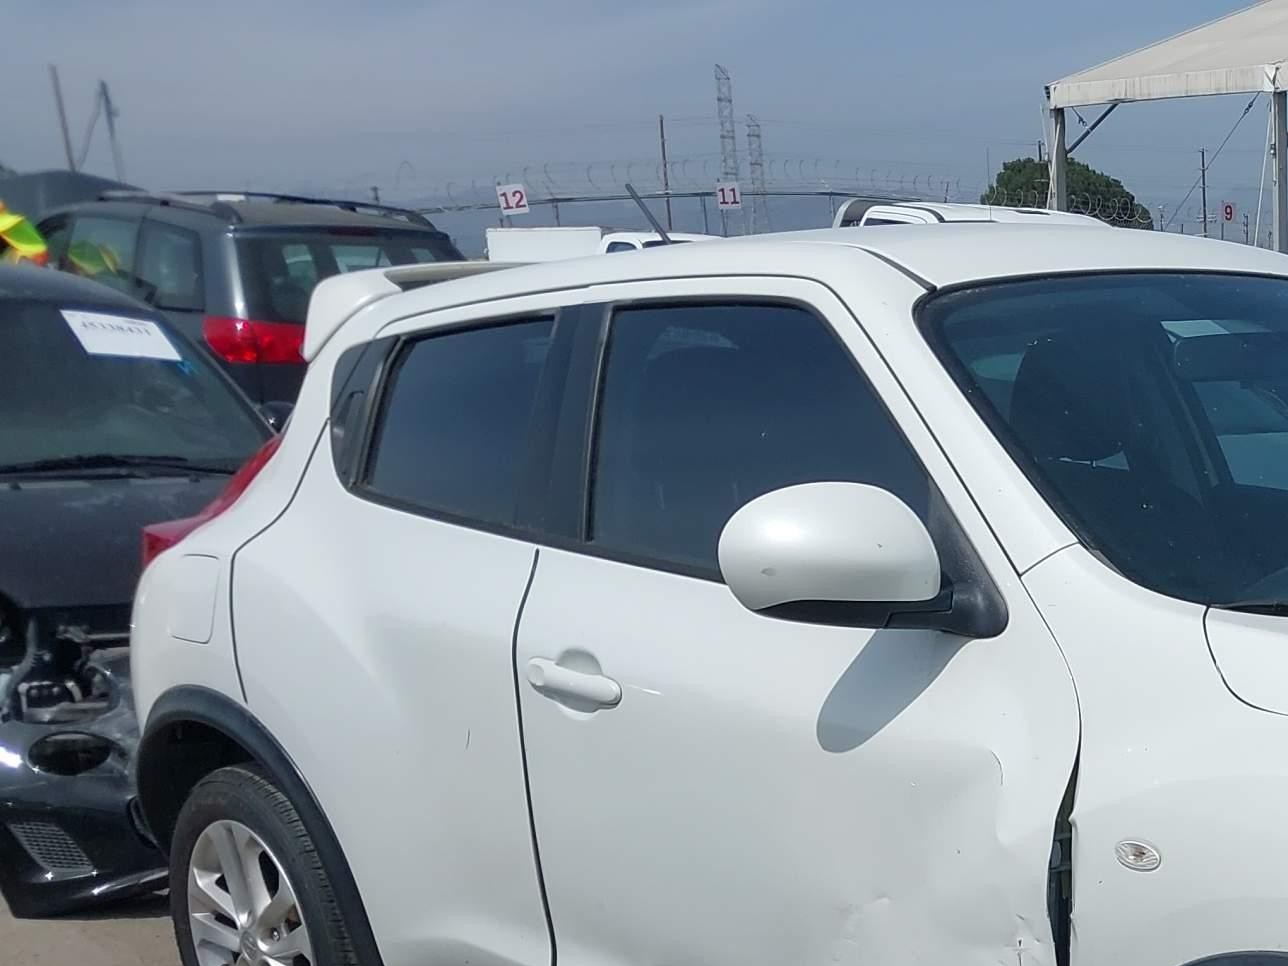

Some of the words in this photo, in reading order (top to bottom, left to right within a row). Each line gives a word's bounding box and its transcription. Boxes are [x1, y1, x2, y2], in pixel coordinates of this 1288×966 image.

[500, 190, 527, 210] 12
[718, 187, 740, 205] 11
[1224, 205, 1233, 221] 9
